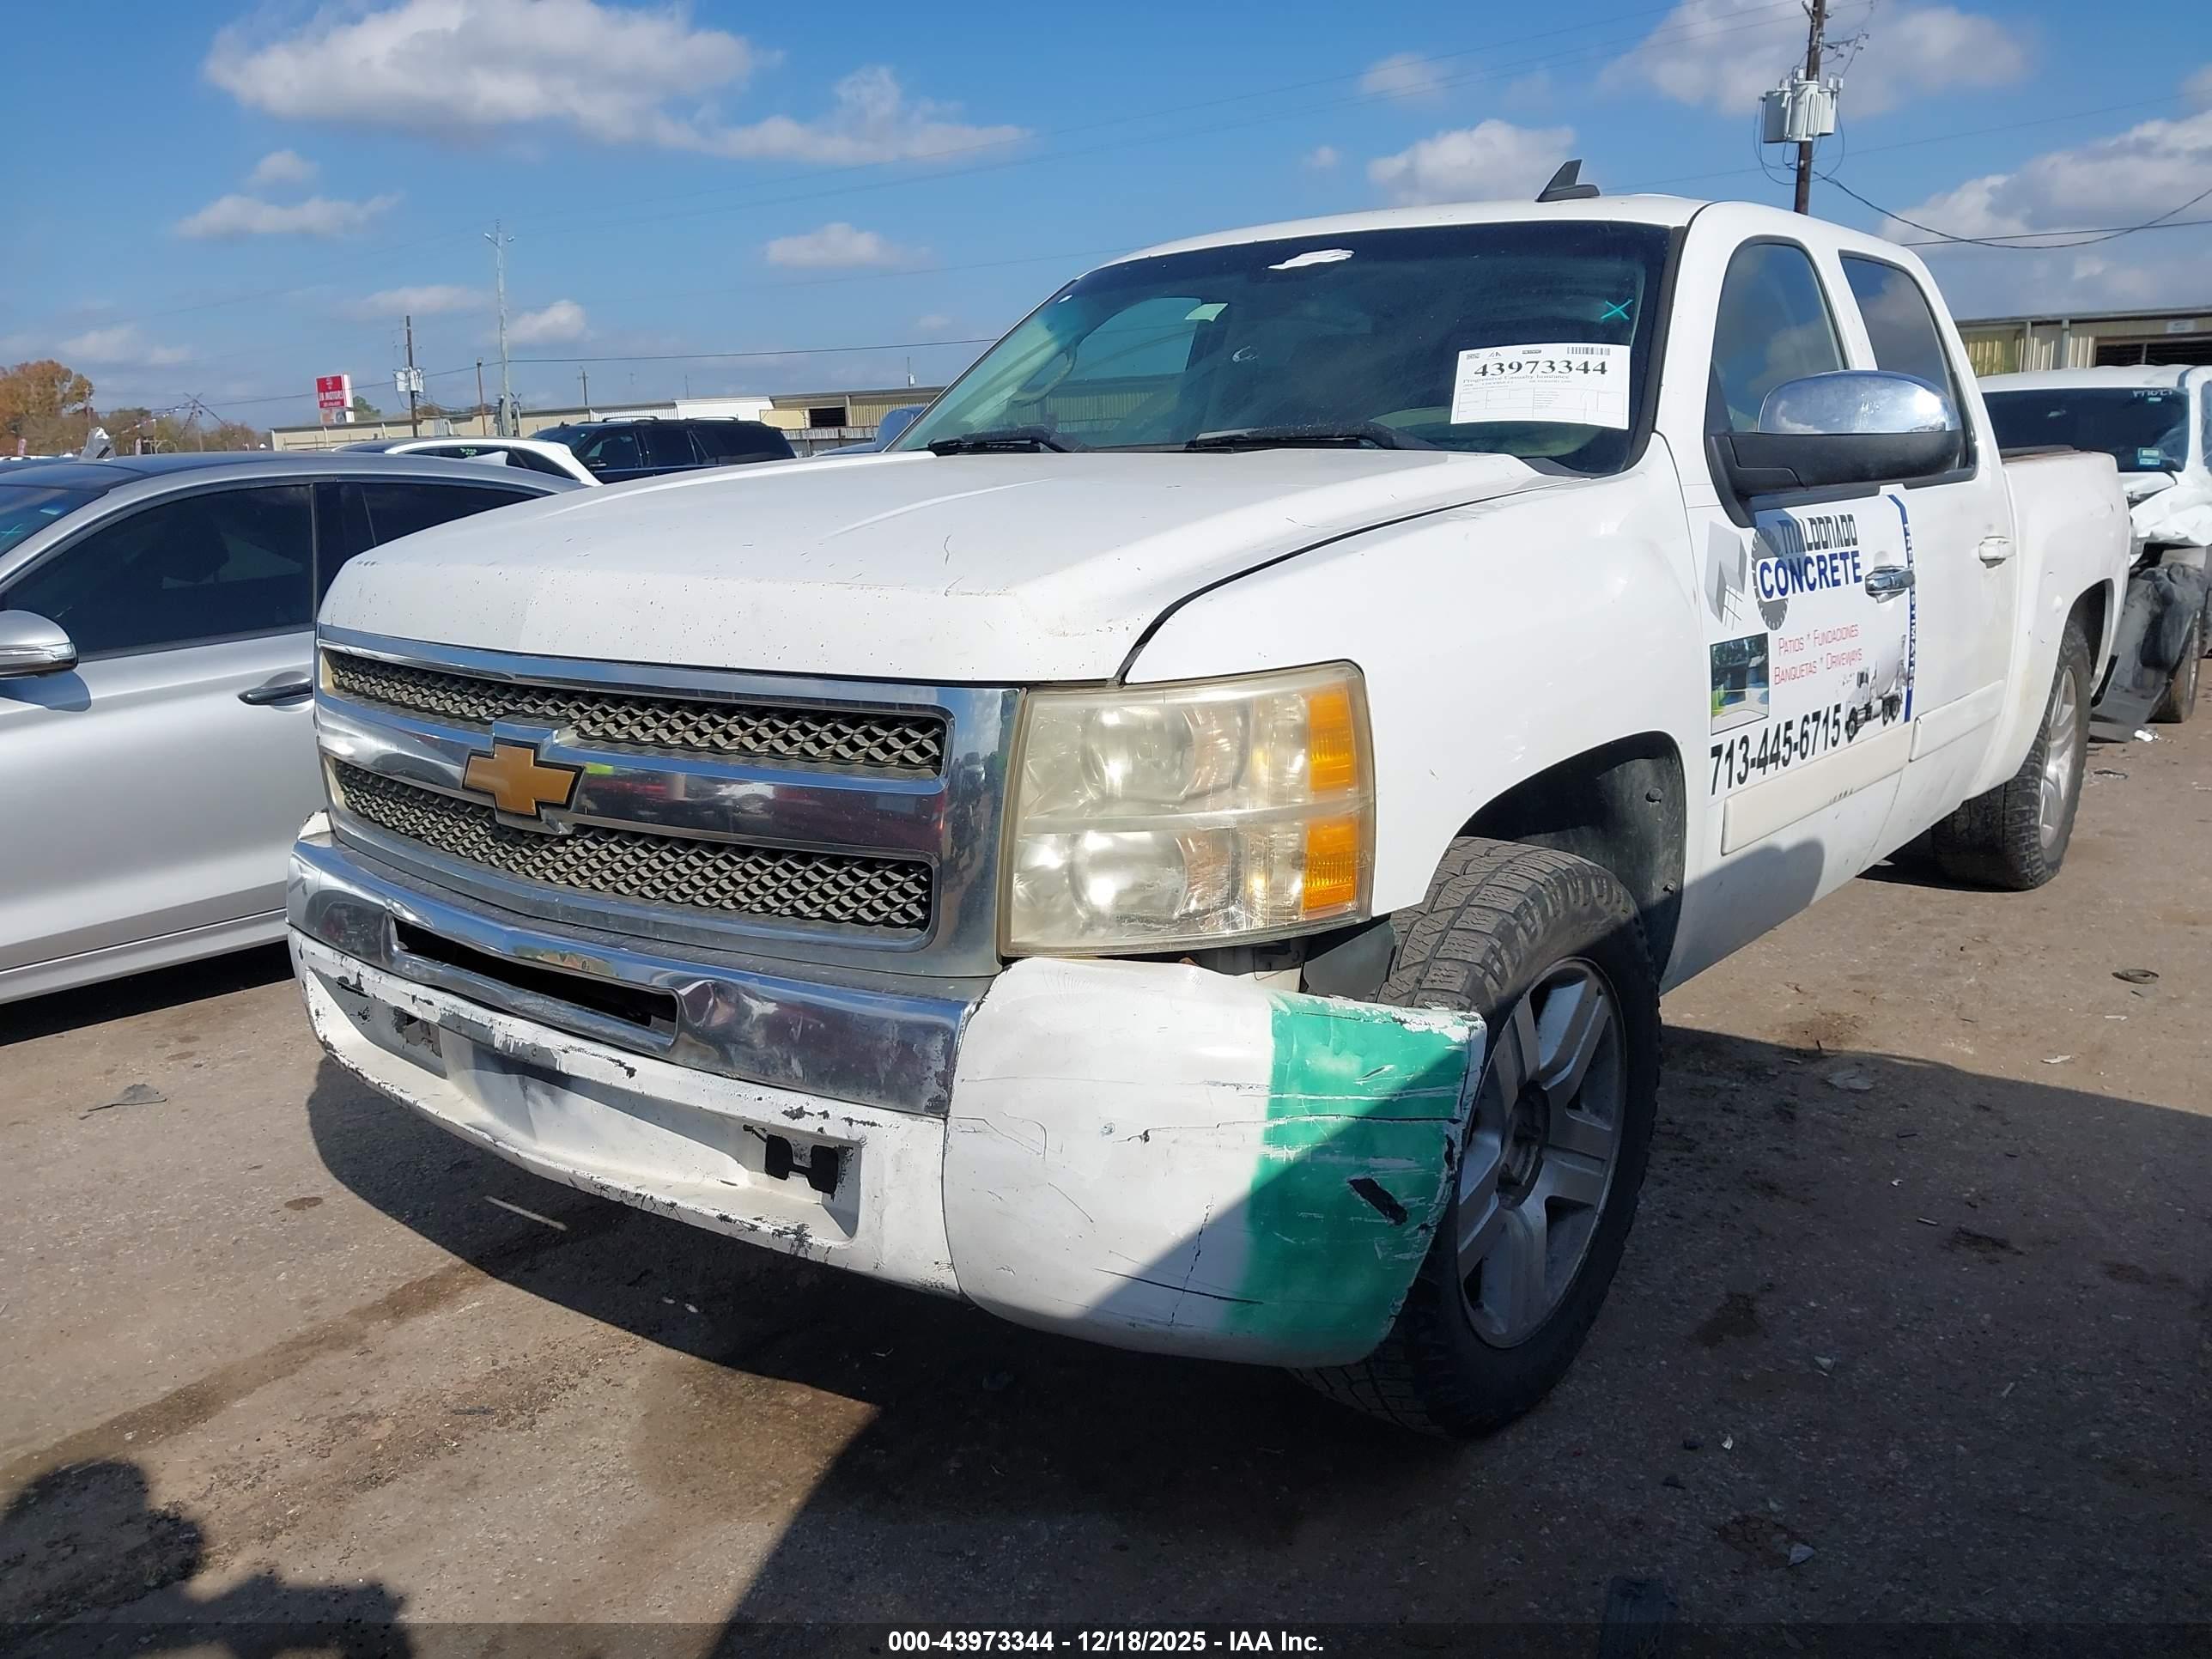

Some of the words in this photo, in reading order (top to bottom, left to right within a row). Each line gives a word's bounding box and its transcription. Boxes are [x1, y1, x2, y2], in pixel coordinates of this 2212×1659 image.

[1474, 360, 1607, 377] 43973344
[1759, 550, 1863, 599] CONCRETE
[1778, 636, 1805, 656] PATIOS
[1710, 703, 1842, 796] 713-445-6715
